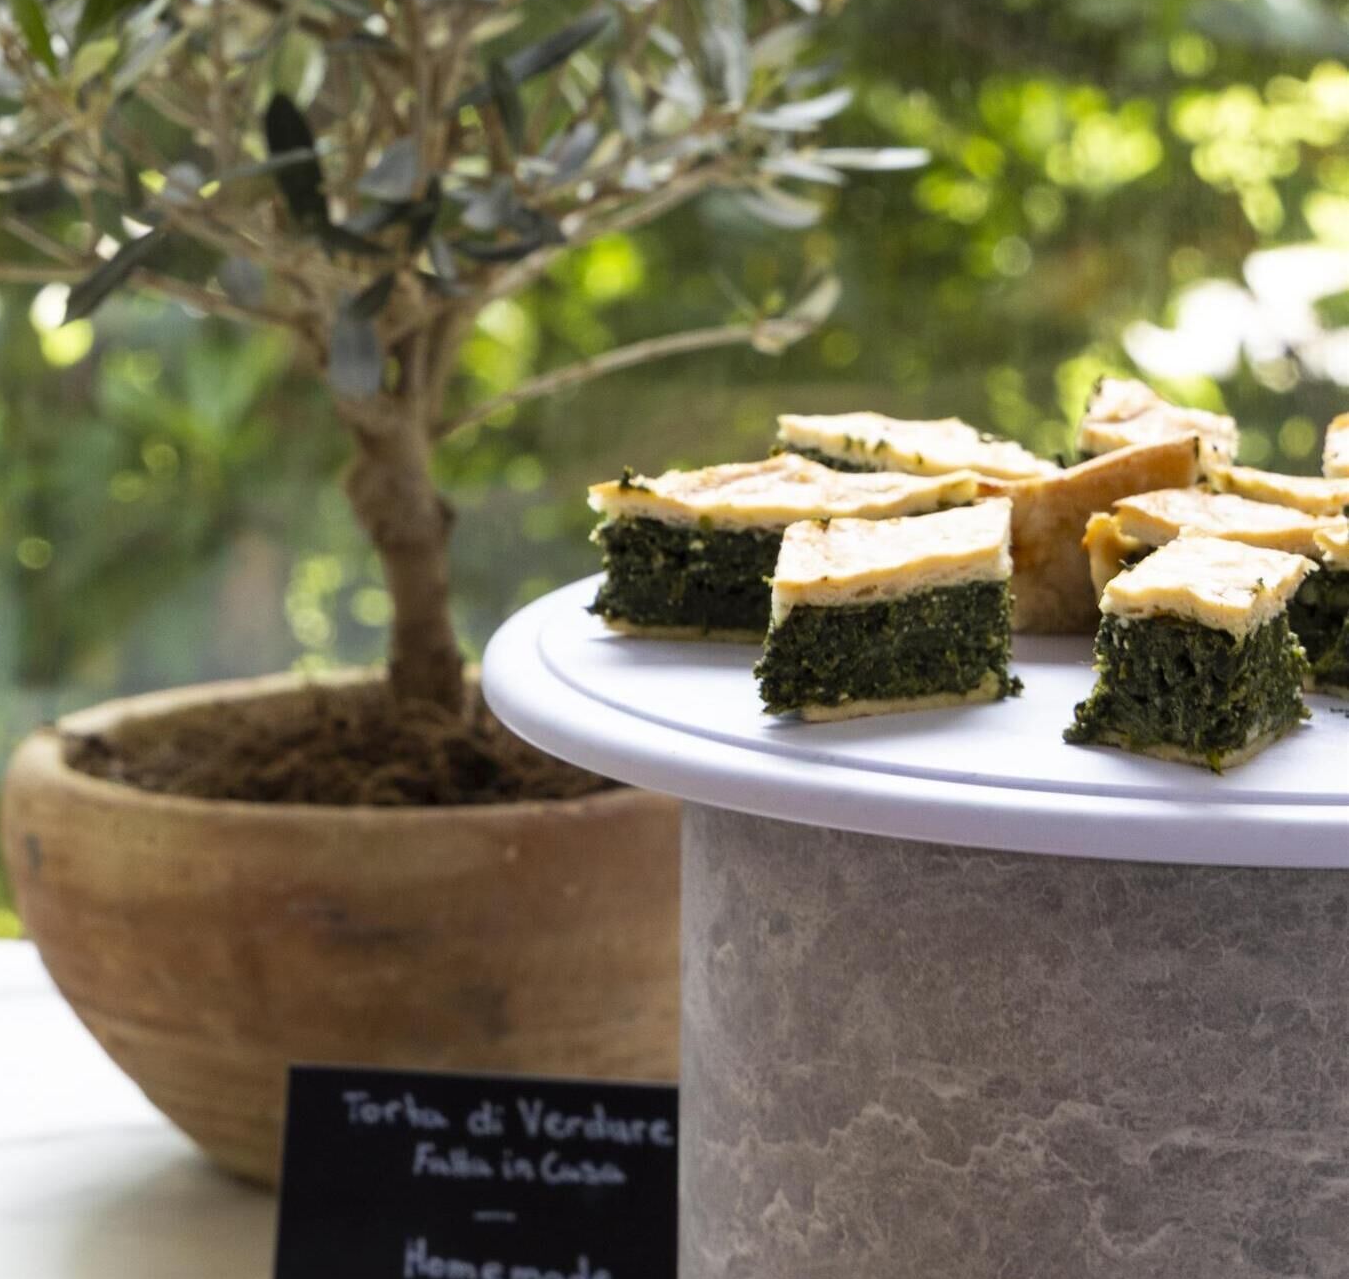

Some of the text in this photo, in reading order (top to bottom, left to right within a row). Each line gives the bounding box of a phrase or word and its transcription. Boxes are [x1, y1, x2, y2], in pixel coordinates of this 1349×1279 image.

[343, 1090, 674, 1147] Torta di Verdure
[412, 1141, 627, 1186] Fatta in Casa
